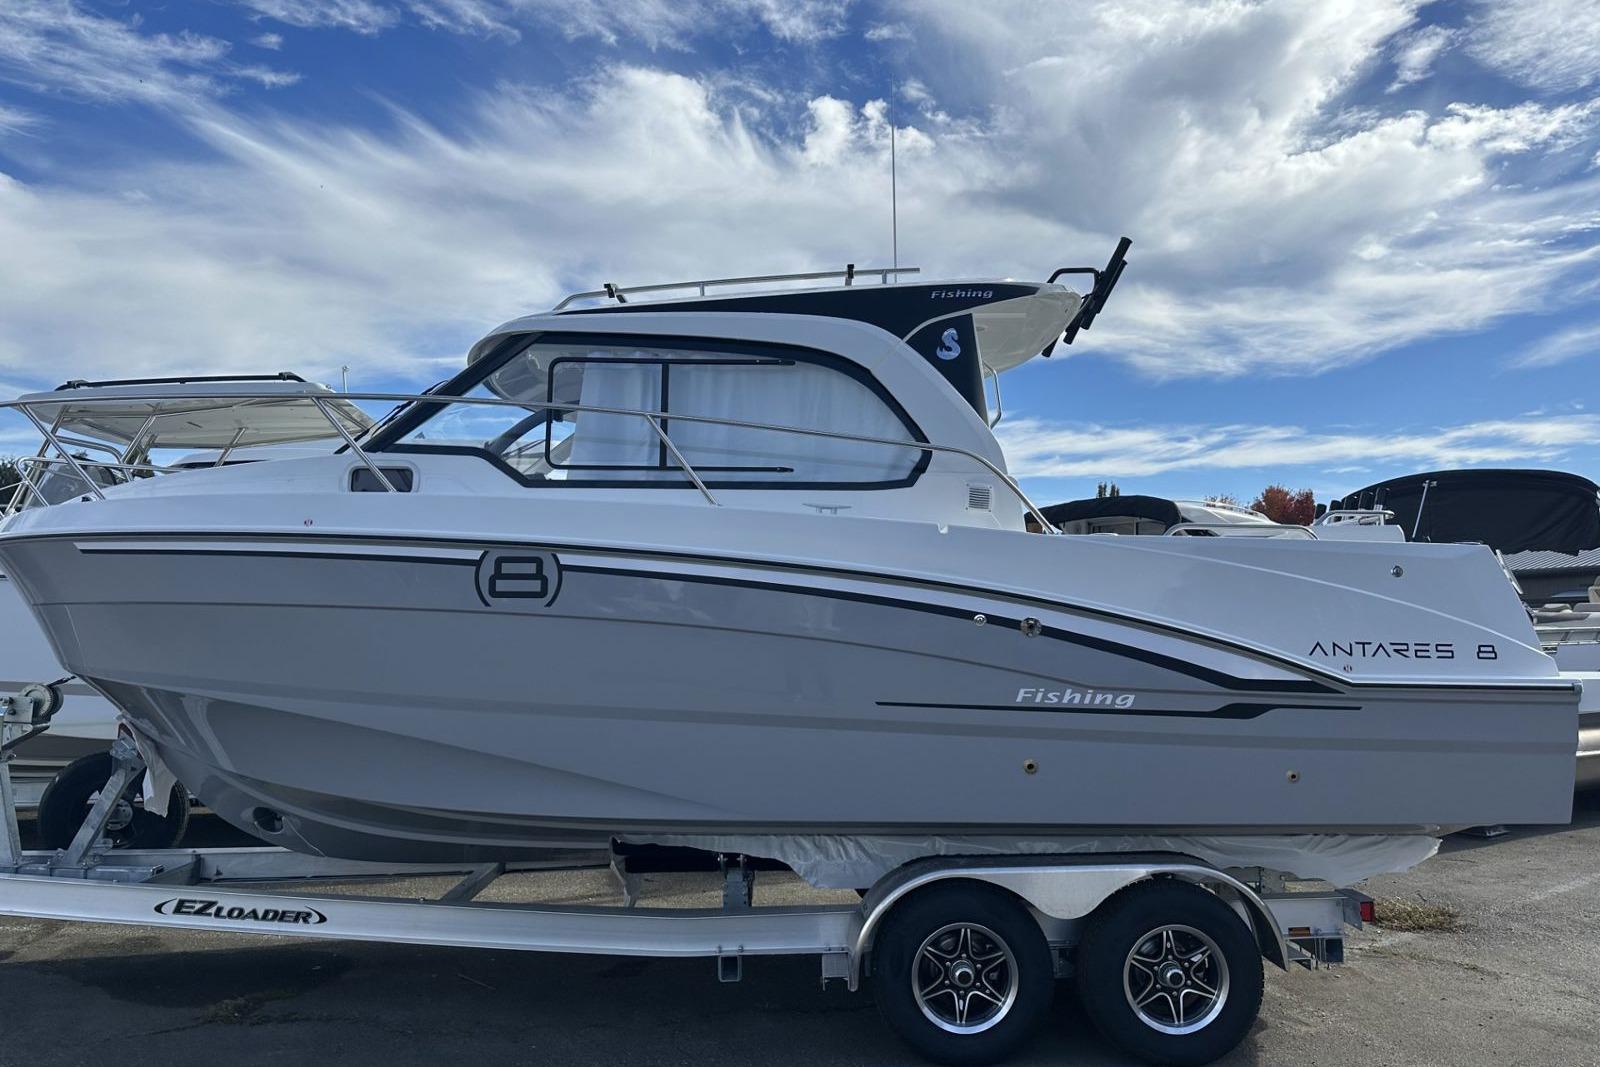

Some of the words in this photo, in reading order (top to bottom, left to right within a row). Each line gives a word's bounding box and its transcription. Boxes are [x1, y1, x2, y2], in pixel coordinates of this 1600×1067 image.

[931, 289, 993, 299] Fishing
[1309, 641, 1455, 659] ANTARES
[1476, 644, 1498, 660] 8
[1015, 688, 1136, 709] Fishing
